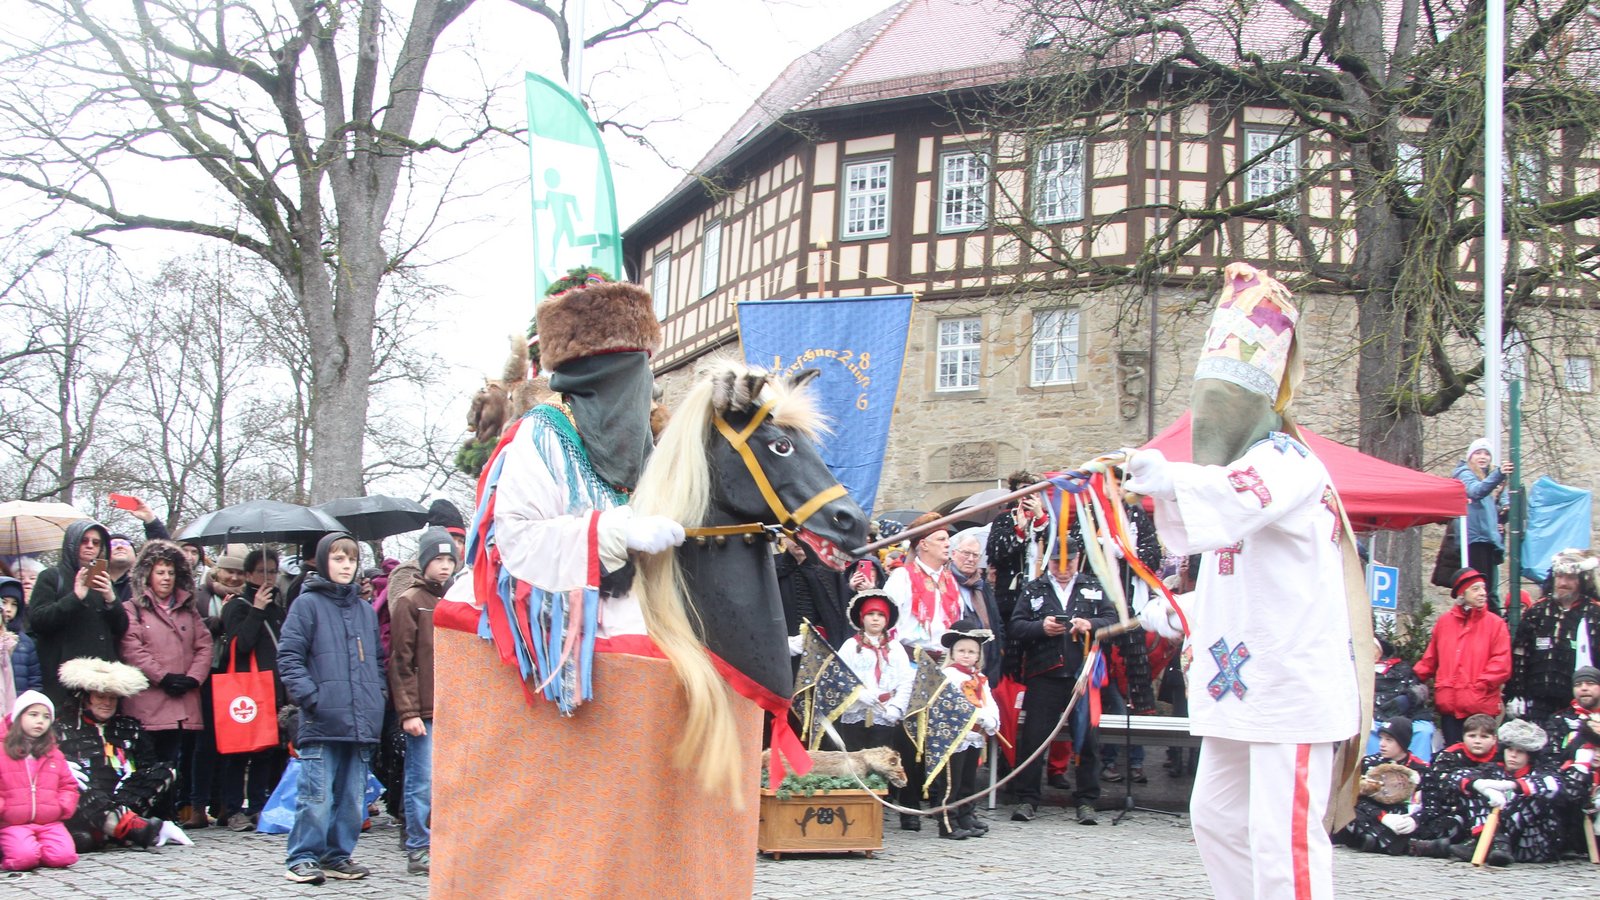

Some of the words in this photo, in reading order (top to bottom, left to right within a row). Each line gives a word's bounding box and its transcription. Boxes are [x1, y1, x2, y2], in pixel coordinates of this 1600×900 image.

[858, 352, 871, 370] 8
[856, 392, 868, 410] 6
[1373, 571, 1391, 602] P
